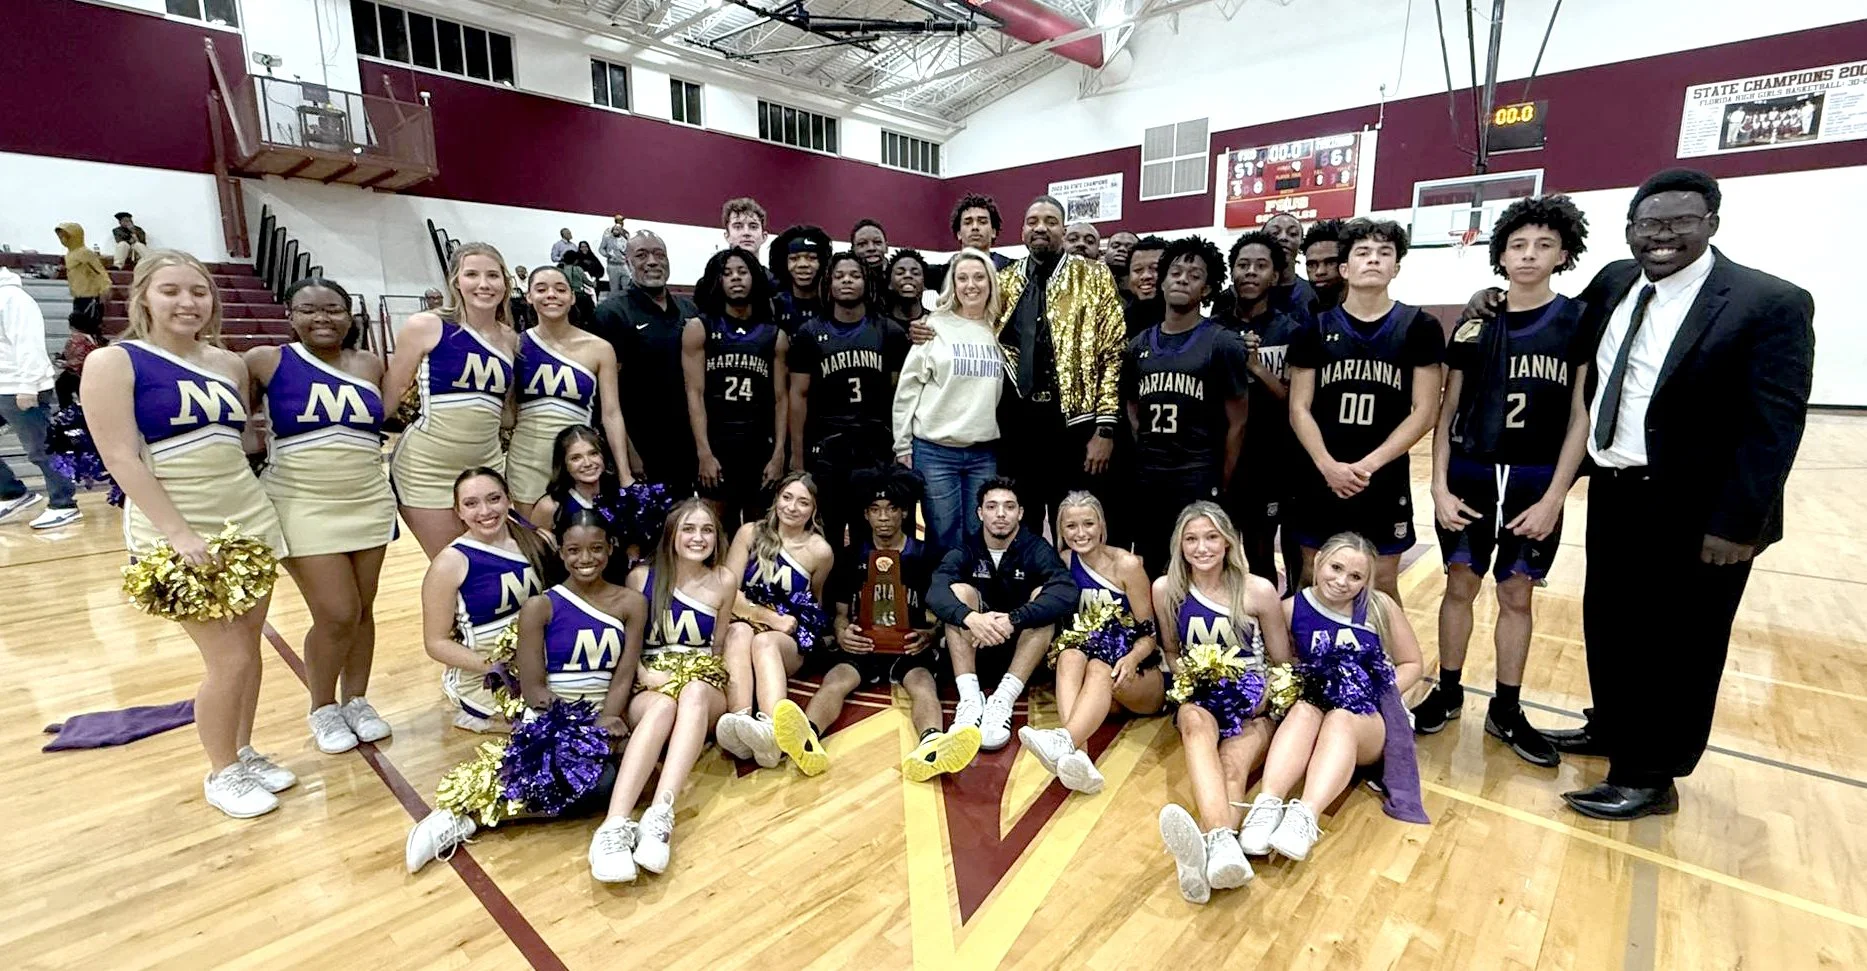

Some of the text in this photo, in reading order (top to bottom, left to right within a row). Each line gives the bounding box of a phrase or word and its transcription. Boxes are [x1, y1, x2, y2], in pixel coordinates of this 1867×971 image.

[1693, 82, 1739, 99] STATE
[1743, 68, 1834, 92] CHAMPIONS
[1699, 96, 1732, 107] FLORIDA
[1735, 92, 1755, 102] HIGH
[1758, 88, 1782, 98] GIRLS
[1495, 105, 1534, 125] 00.0
[706, 353, 769, 378] MARIANNA
[952, 343, 1000, 360] MARIANN
[452, 352, 507, 394] M
[524, 363, 582, 400] M
[1321, 359, 1402, 391] MARIANNA
[1508, 354, 1568, 386] IANNA
[170, 380, 248, 426] M
[296, 382, 374, 424] M
[724, 376, 753, 402] 24
[848, 377, 862, 403] 3
[1149, 403, 1179, 434] 23
[1338, 392, 1376, 426] 00
[1505, 393, 1527, 429] 2
[494, 566, 544, 615] M
[746, 564, 793, 595] M
[645, 610, 706, 646] M
[1186, 616, 1241, 652] M
[562, 627, 622, 671] M
